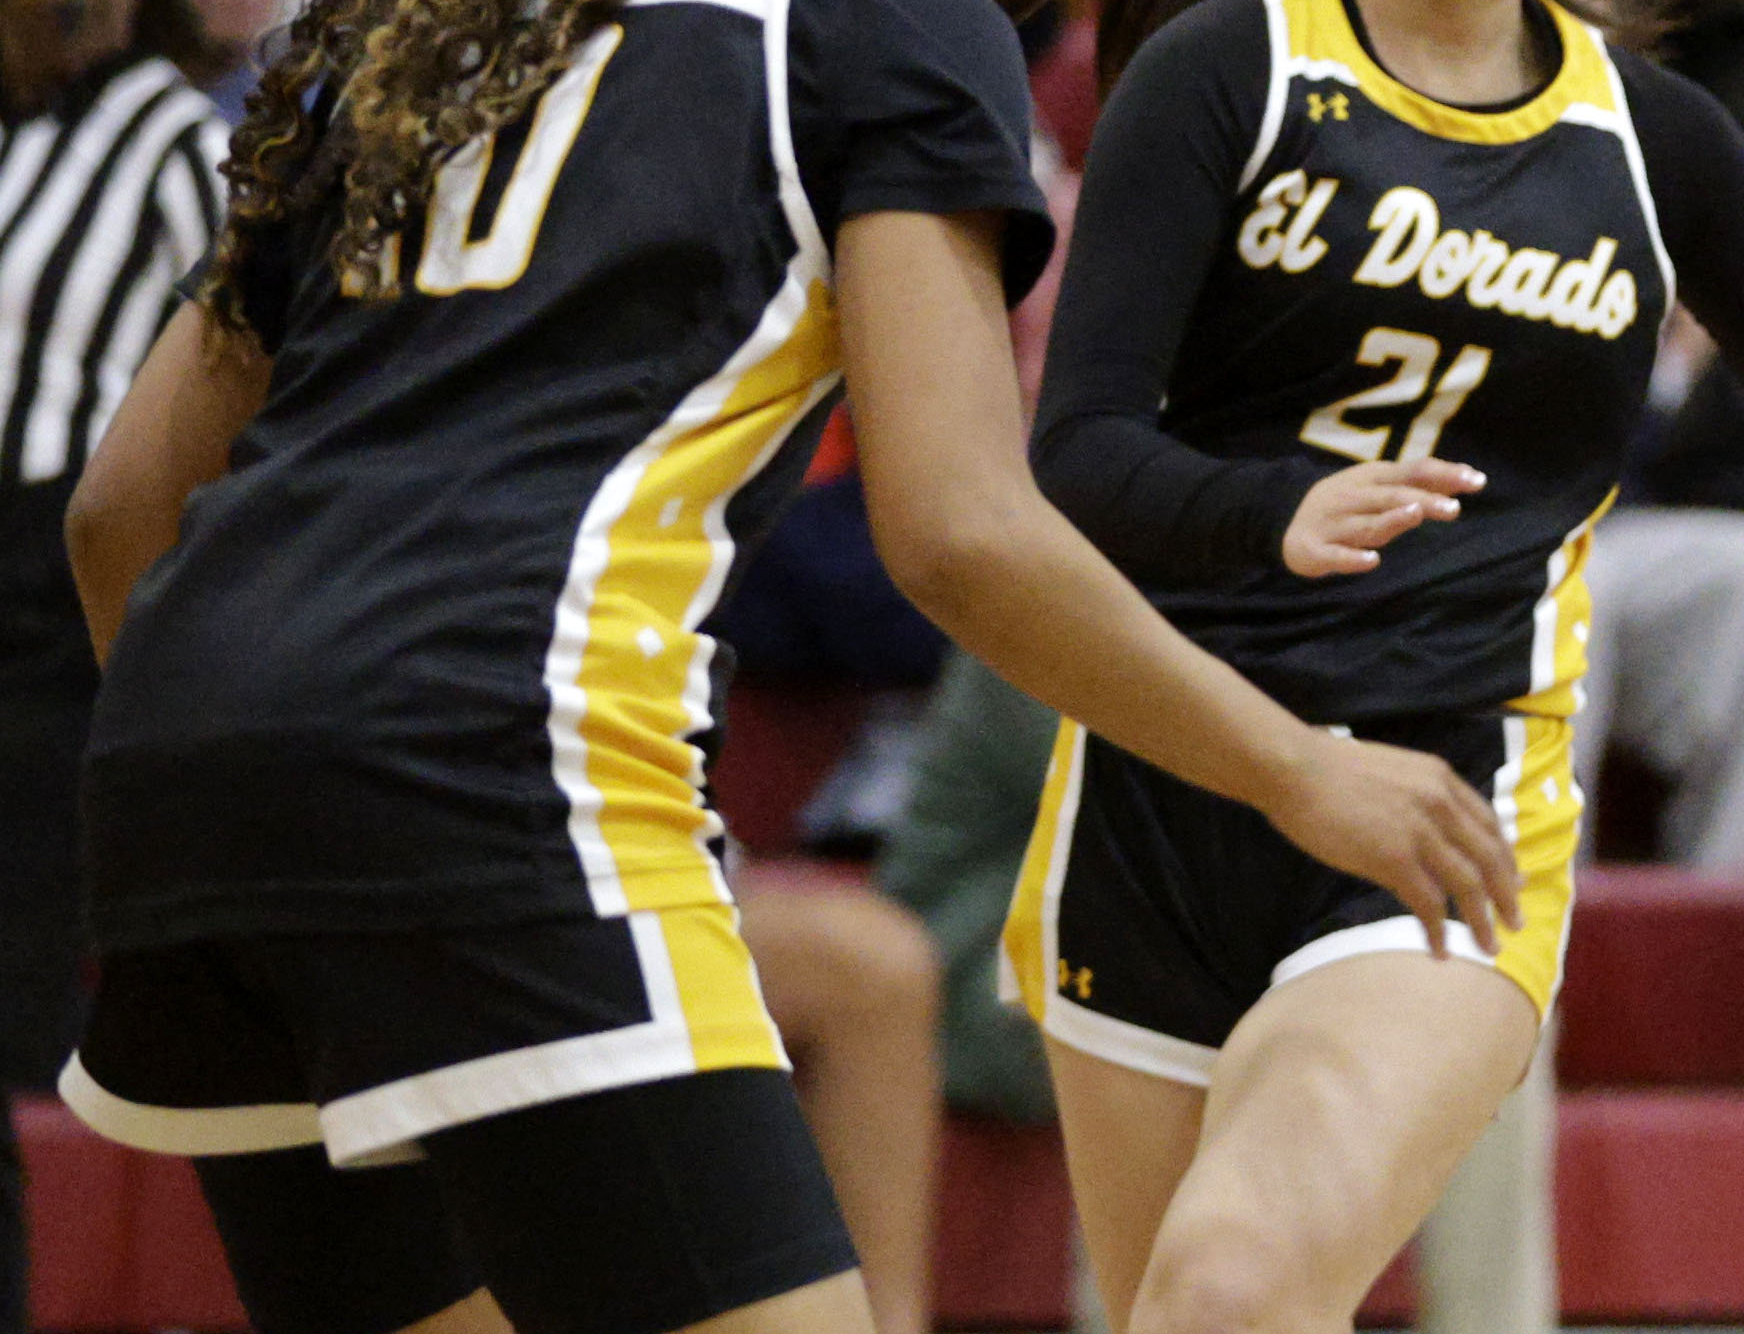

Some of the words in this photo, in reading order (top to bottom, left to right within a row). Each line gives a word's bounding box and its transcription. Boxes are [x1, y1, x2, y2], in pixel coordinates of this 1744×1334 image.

[1237, 168, 1339, 274] El
[1353, 185, 1639, 341] Dorado
[1298, 325, 1493, 463] 21
